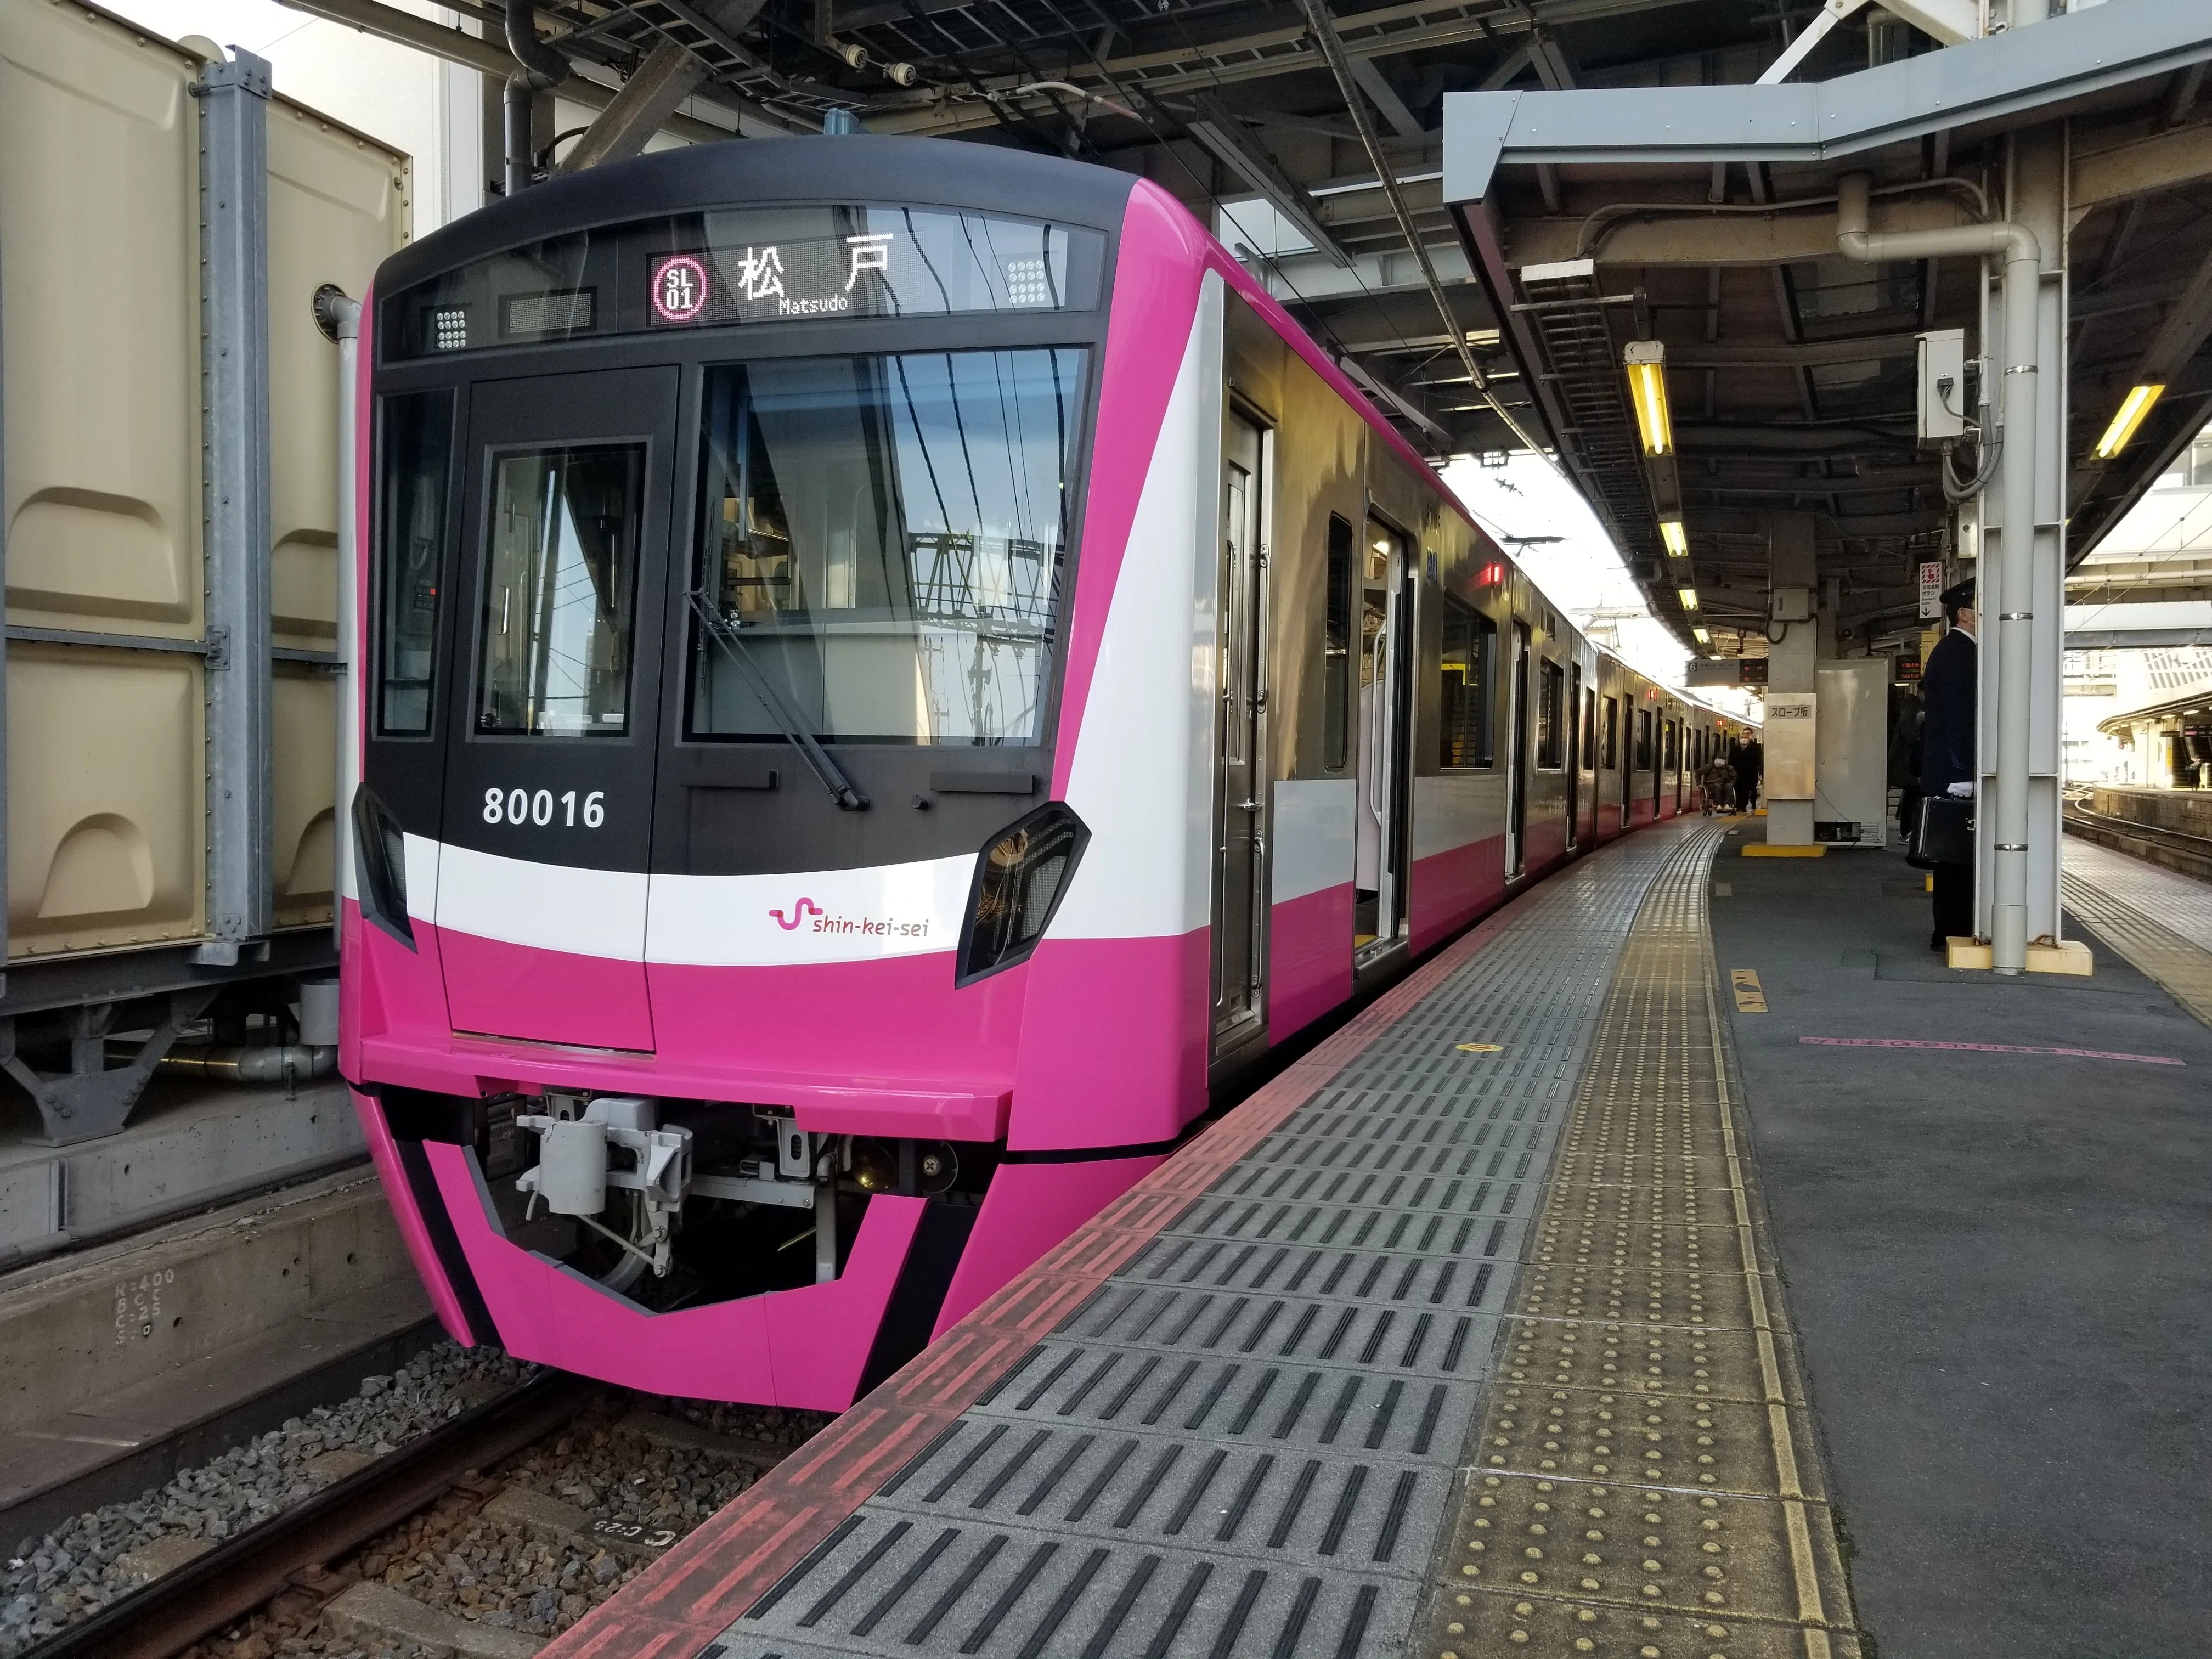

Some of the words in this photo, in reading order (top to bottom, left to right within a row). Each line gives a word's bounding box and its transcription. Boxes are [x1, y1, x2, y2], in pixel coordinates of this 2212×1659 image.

[738, 233, 894, 301] 松戸
[667, 268, 694, 289] SL
[667, 287, 693, 309] 01
[779, 294, 848, 315] Matsudo
[1689, 663, 1696, 671] 6
[1771, 706, 1808, 718] スロープ板
[483, 787, 605, 828] 80016
[812, 915, 929, 937] shin-kei-sei
